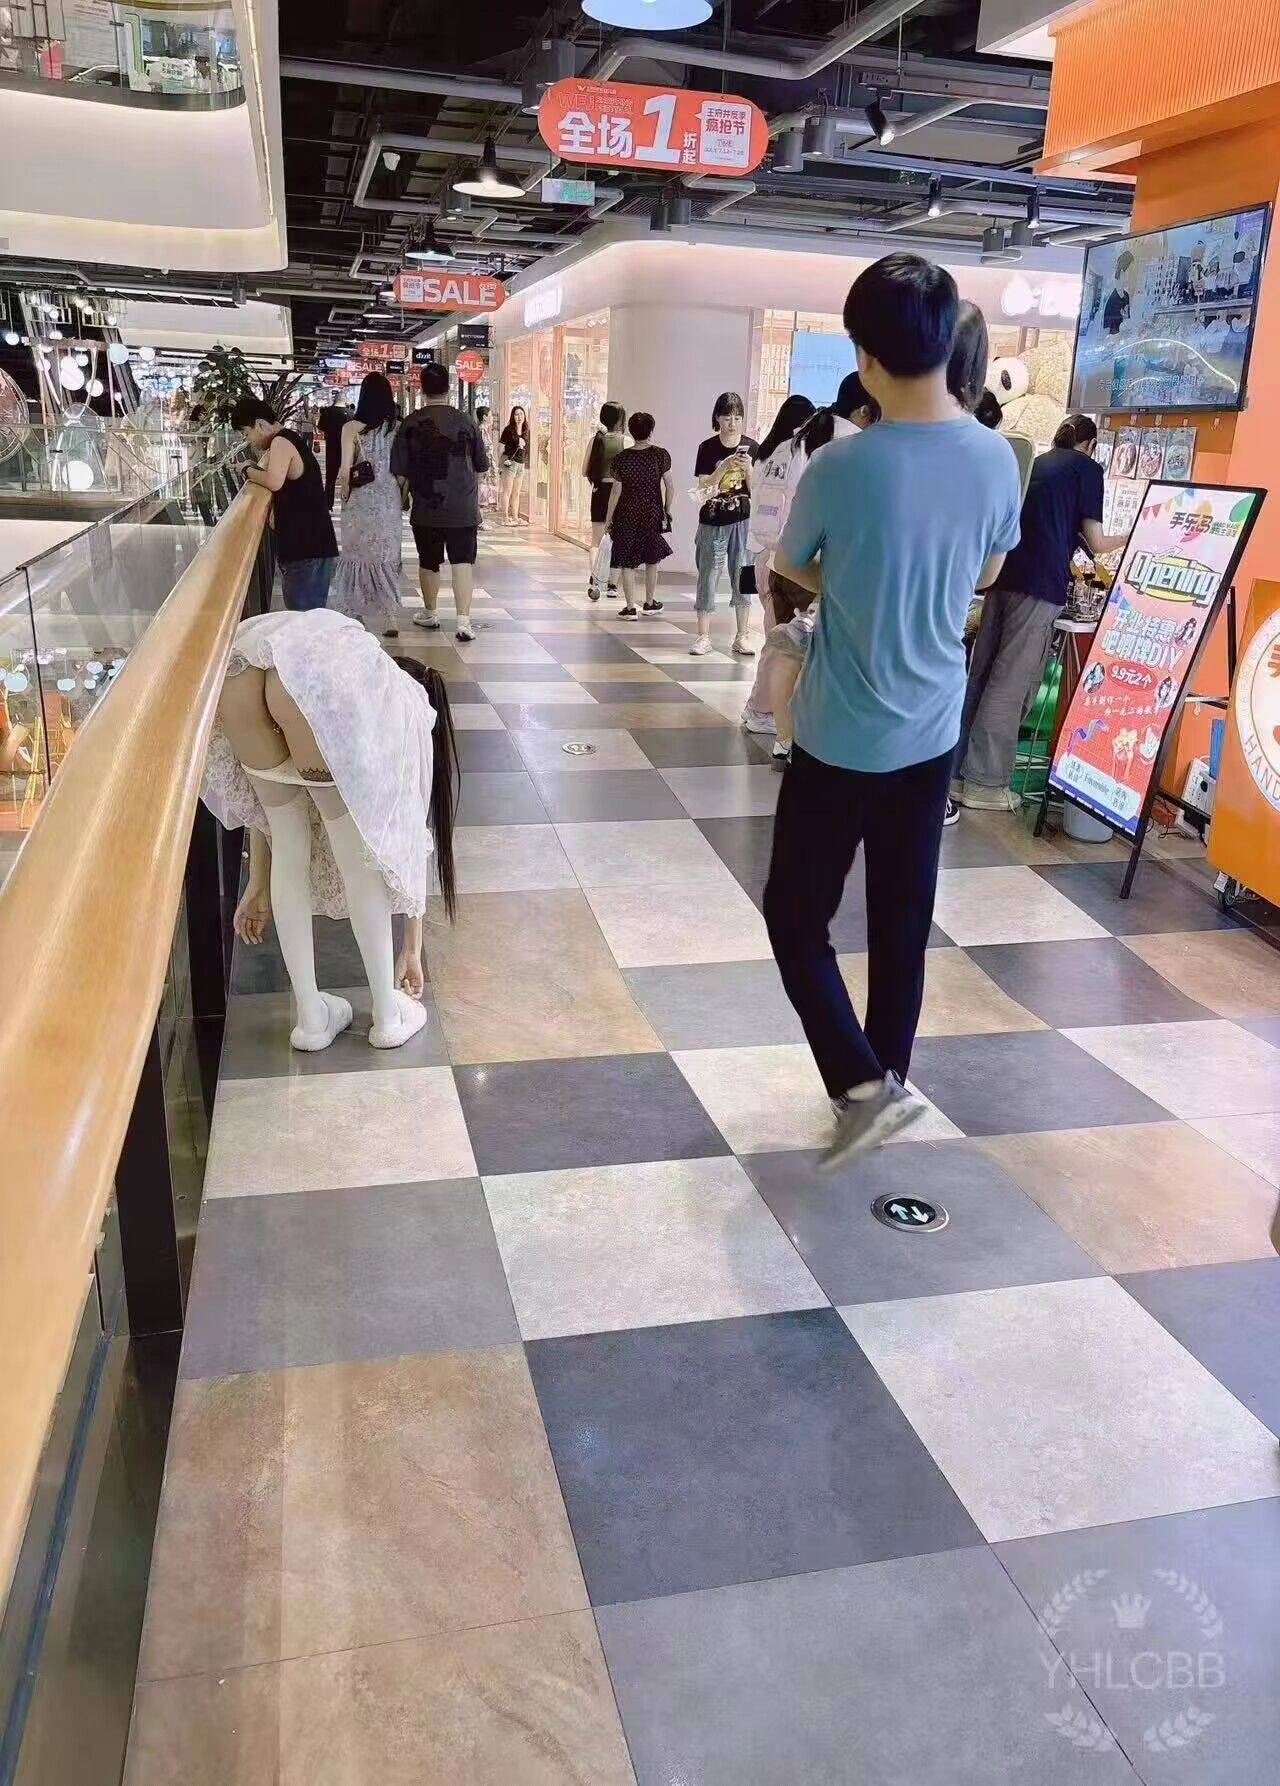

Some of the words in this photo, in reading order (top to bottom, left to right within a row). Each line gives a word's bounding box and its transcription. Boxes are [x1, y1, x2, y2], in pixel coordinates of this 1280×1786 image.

[558, 111, 632, 157] 全场
[635, 94, 680, 164] 1
[682, 132, 696, 165] 折起
[706, 119, 745, 135] 疯抢节
[423, 278, 497, 307] SALE
[355, 361, 383, 372] SALE
[455, 360, 484, 371] SALE
[1128, 551, 1221, 605] Opening
